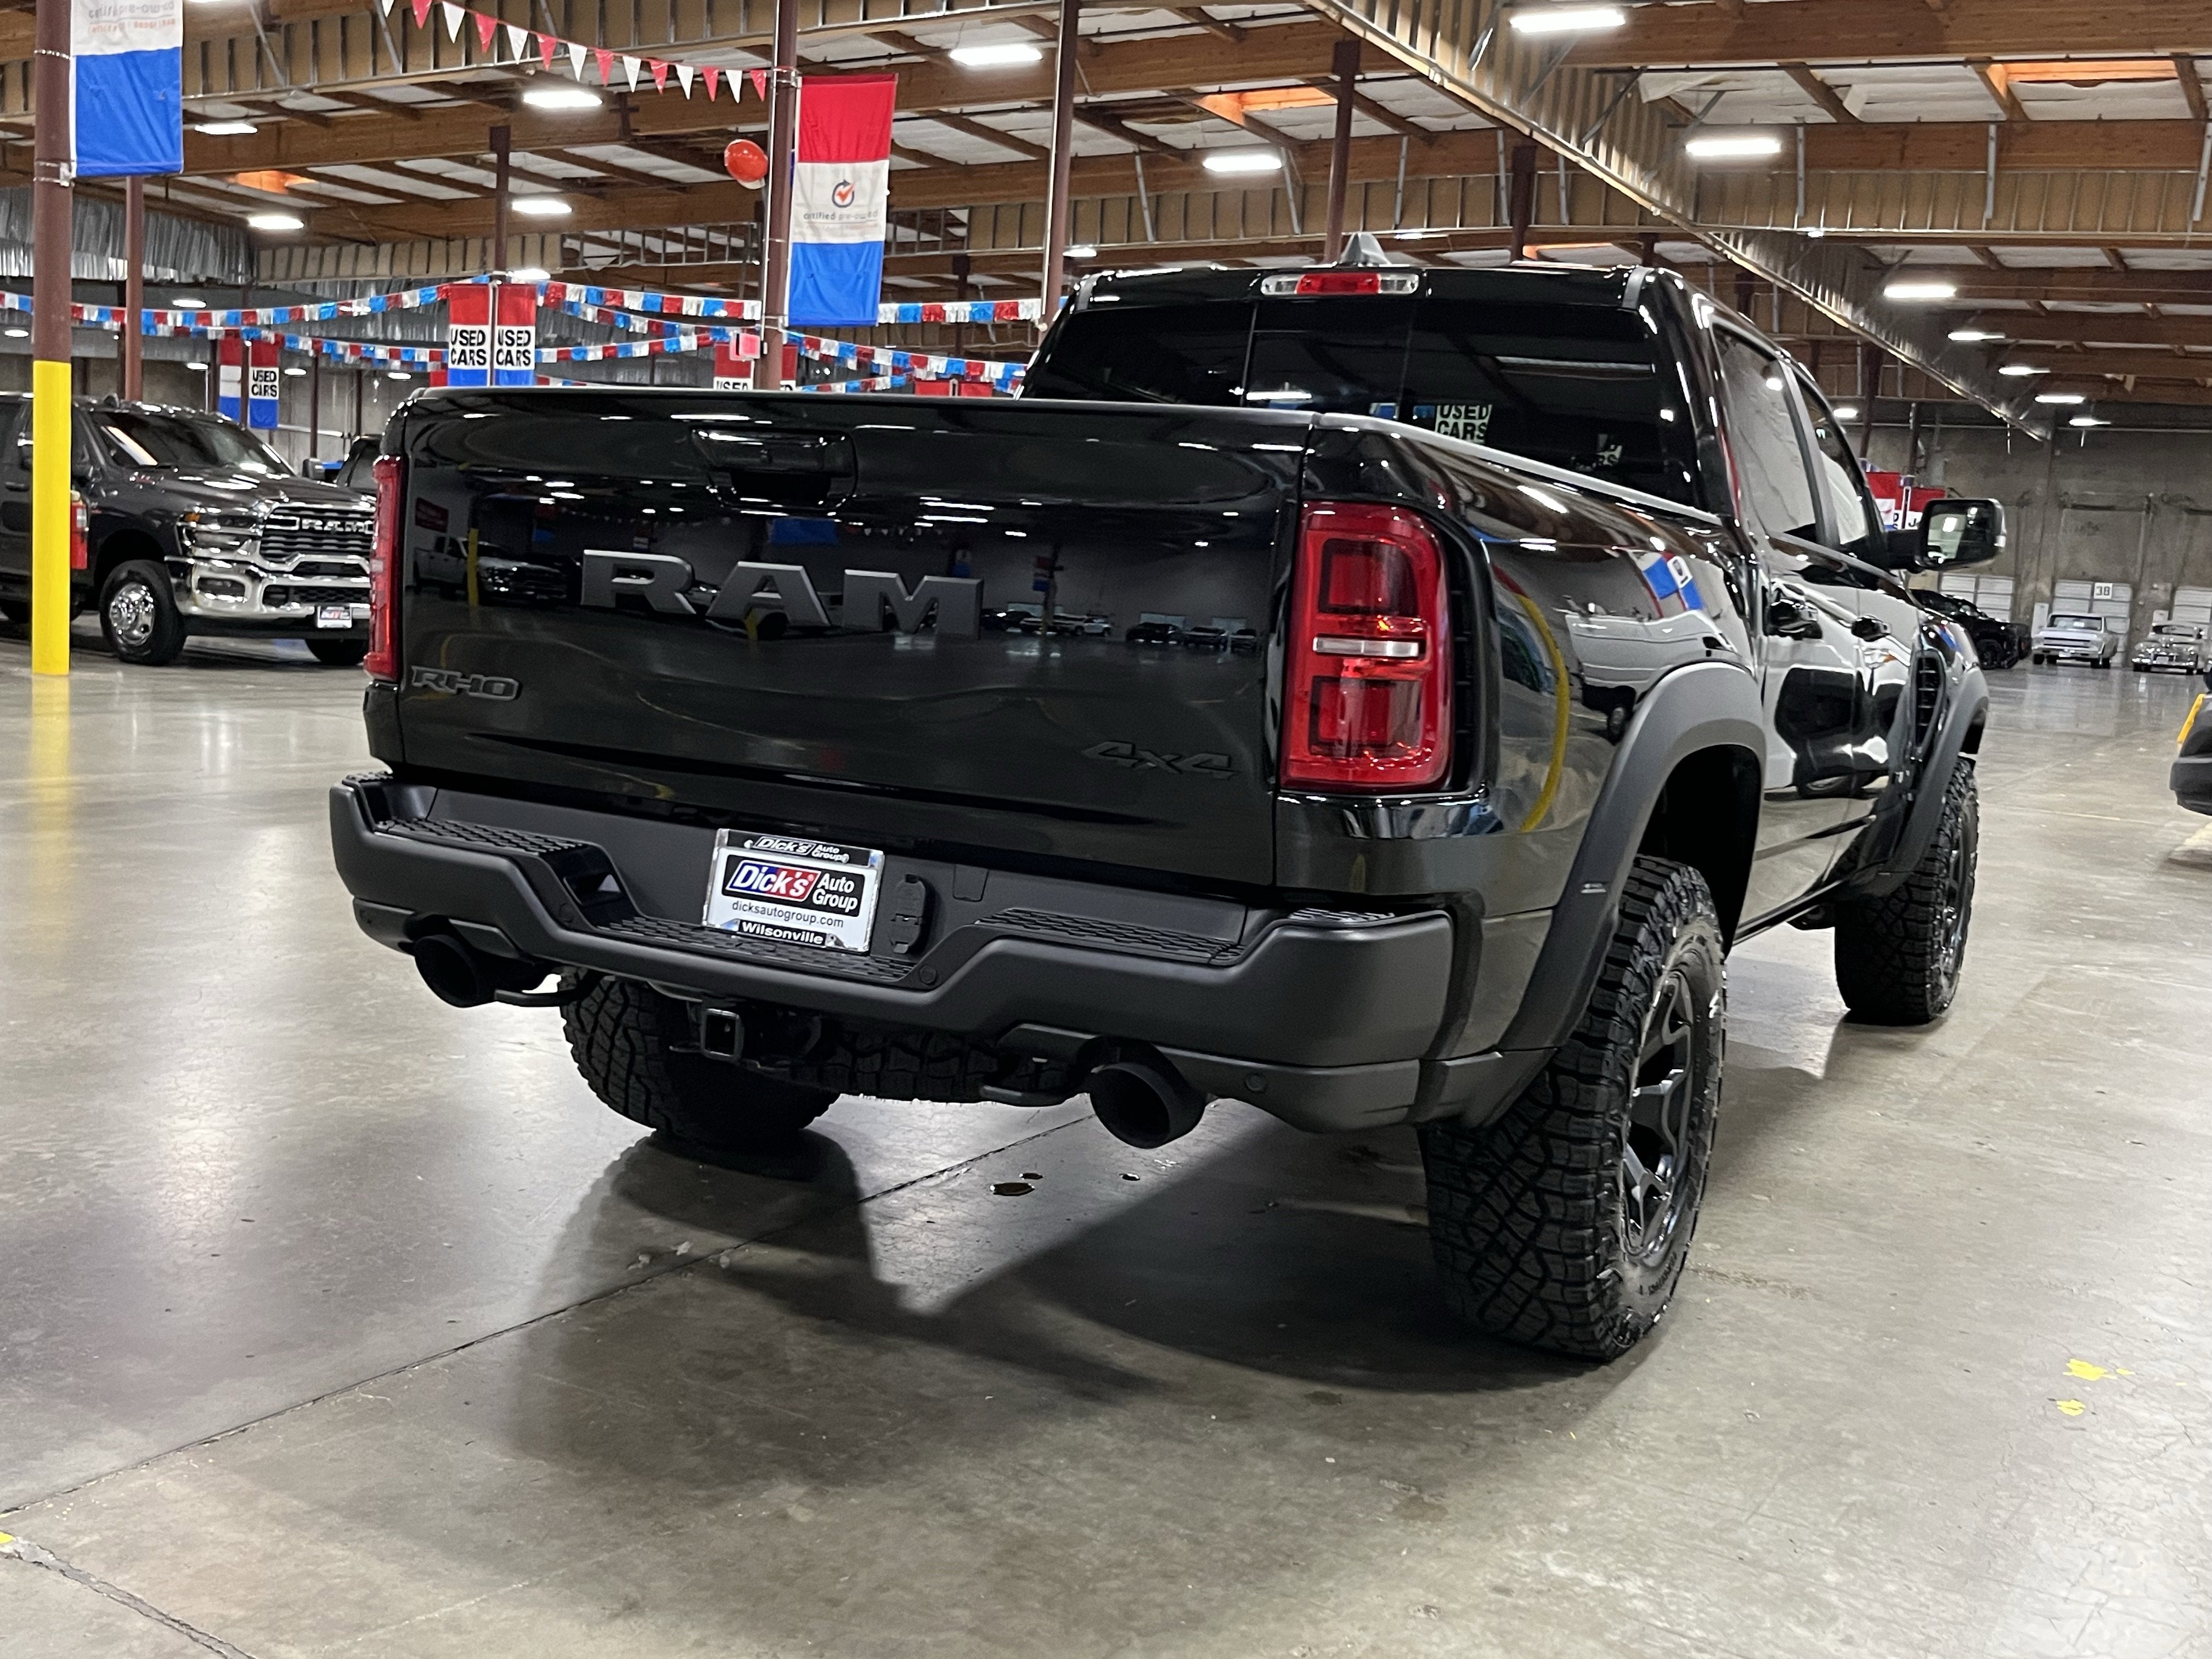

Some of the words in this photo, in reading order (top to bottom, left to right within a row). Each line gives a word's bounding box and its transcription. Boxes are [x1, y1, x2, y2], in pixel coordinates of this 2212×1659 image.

[451, 329, 486, 346] USED
[498, 329, 531, 346] USED
[451, 348, 487, 365] CARS
[496, 348, 531, 366] CARS
[252, 370, 277, 382] USED
[1440, 405, 1489, 420] USED
[1437, 420, 1487, 441] CARS
[302, 518, 364, 532] RAM
[581, 549, 984, 640] RAM
[2096, 586, 2110, 596] 38
[411, 665, 520, 701] RHO
[757, 838, 812, 854] Dick's
[815, 844, 840, 854] Auto
[811, 849, 844, 862] Group
[732, 865, 809, 898] Dick's
[817, 873, 855, 893] Auto
[812, 888, 858, 913] Group
[732, 900, 844, 928] dicksautogroup.com
[742, 922, 824, 945] Wilsonville
